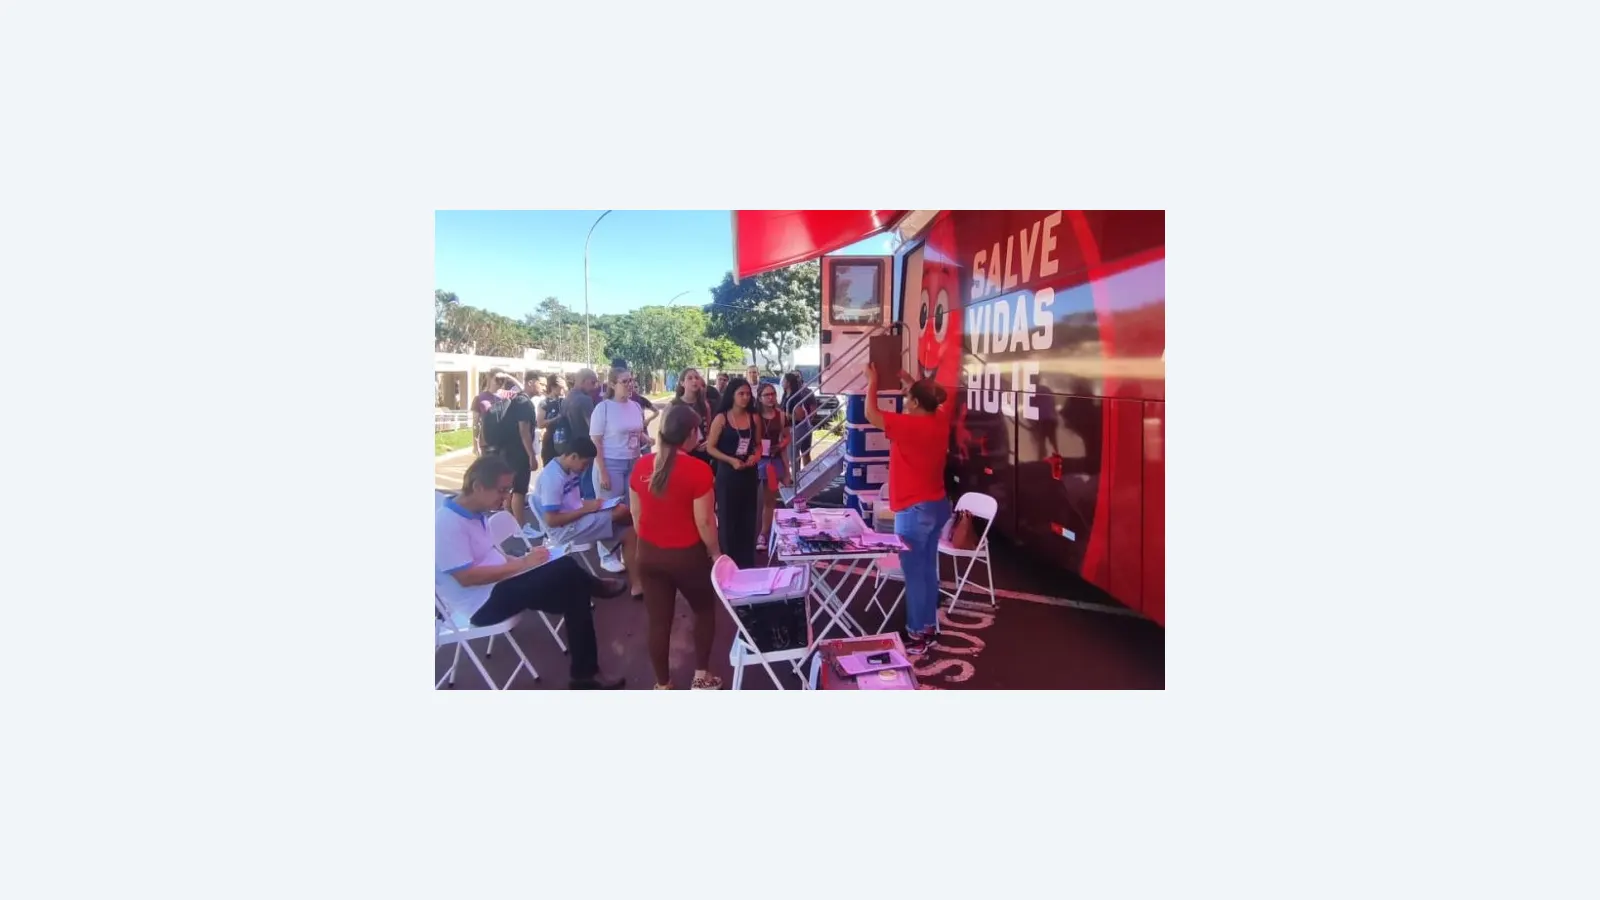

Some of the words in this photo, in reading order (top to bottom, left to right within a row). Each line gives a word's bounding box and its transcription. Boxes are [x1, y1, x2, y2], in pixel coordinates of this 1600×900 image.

[970, 211, 1062, 299] SALVE
[969, 286, 1055, 355] VIDAS
[967, 362, 1040, 421] HOJE
[908, 598, 999, 690] IDOS
